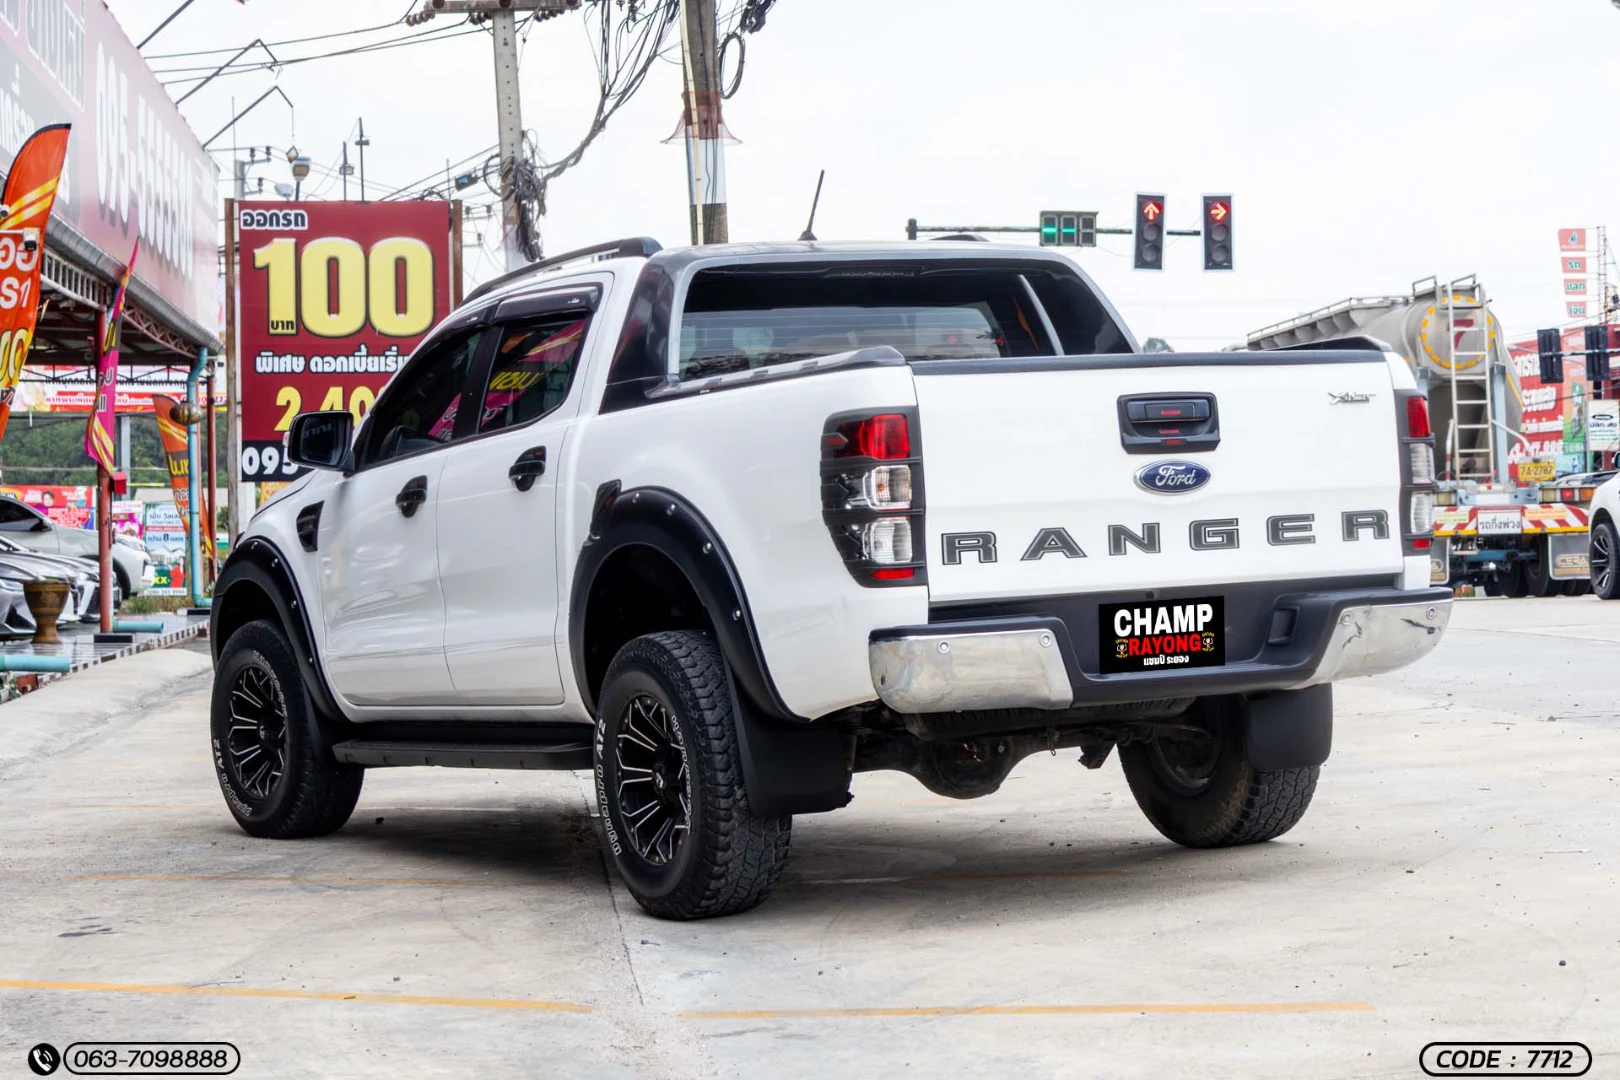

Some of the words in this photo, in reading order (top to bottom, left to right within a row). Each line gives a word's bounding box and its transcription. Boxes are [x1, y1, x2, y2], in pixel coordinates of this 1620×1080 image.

[241, 211, 307, 229] ออกรถ
[253, 236, 434, 338] 100
[270, 320, 295, 331] บาท
[255, 350, 305, 373] พิเศษ
[1156, 465, 1197, 486] Ford
[941, 509, 1389, 565] RANGER
[1114, 604, 1213, 637] CHAMP
[1128, 633, 1202, 656] RAYONG
